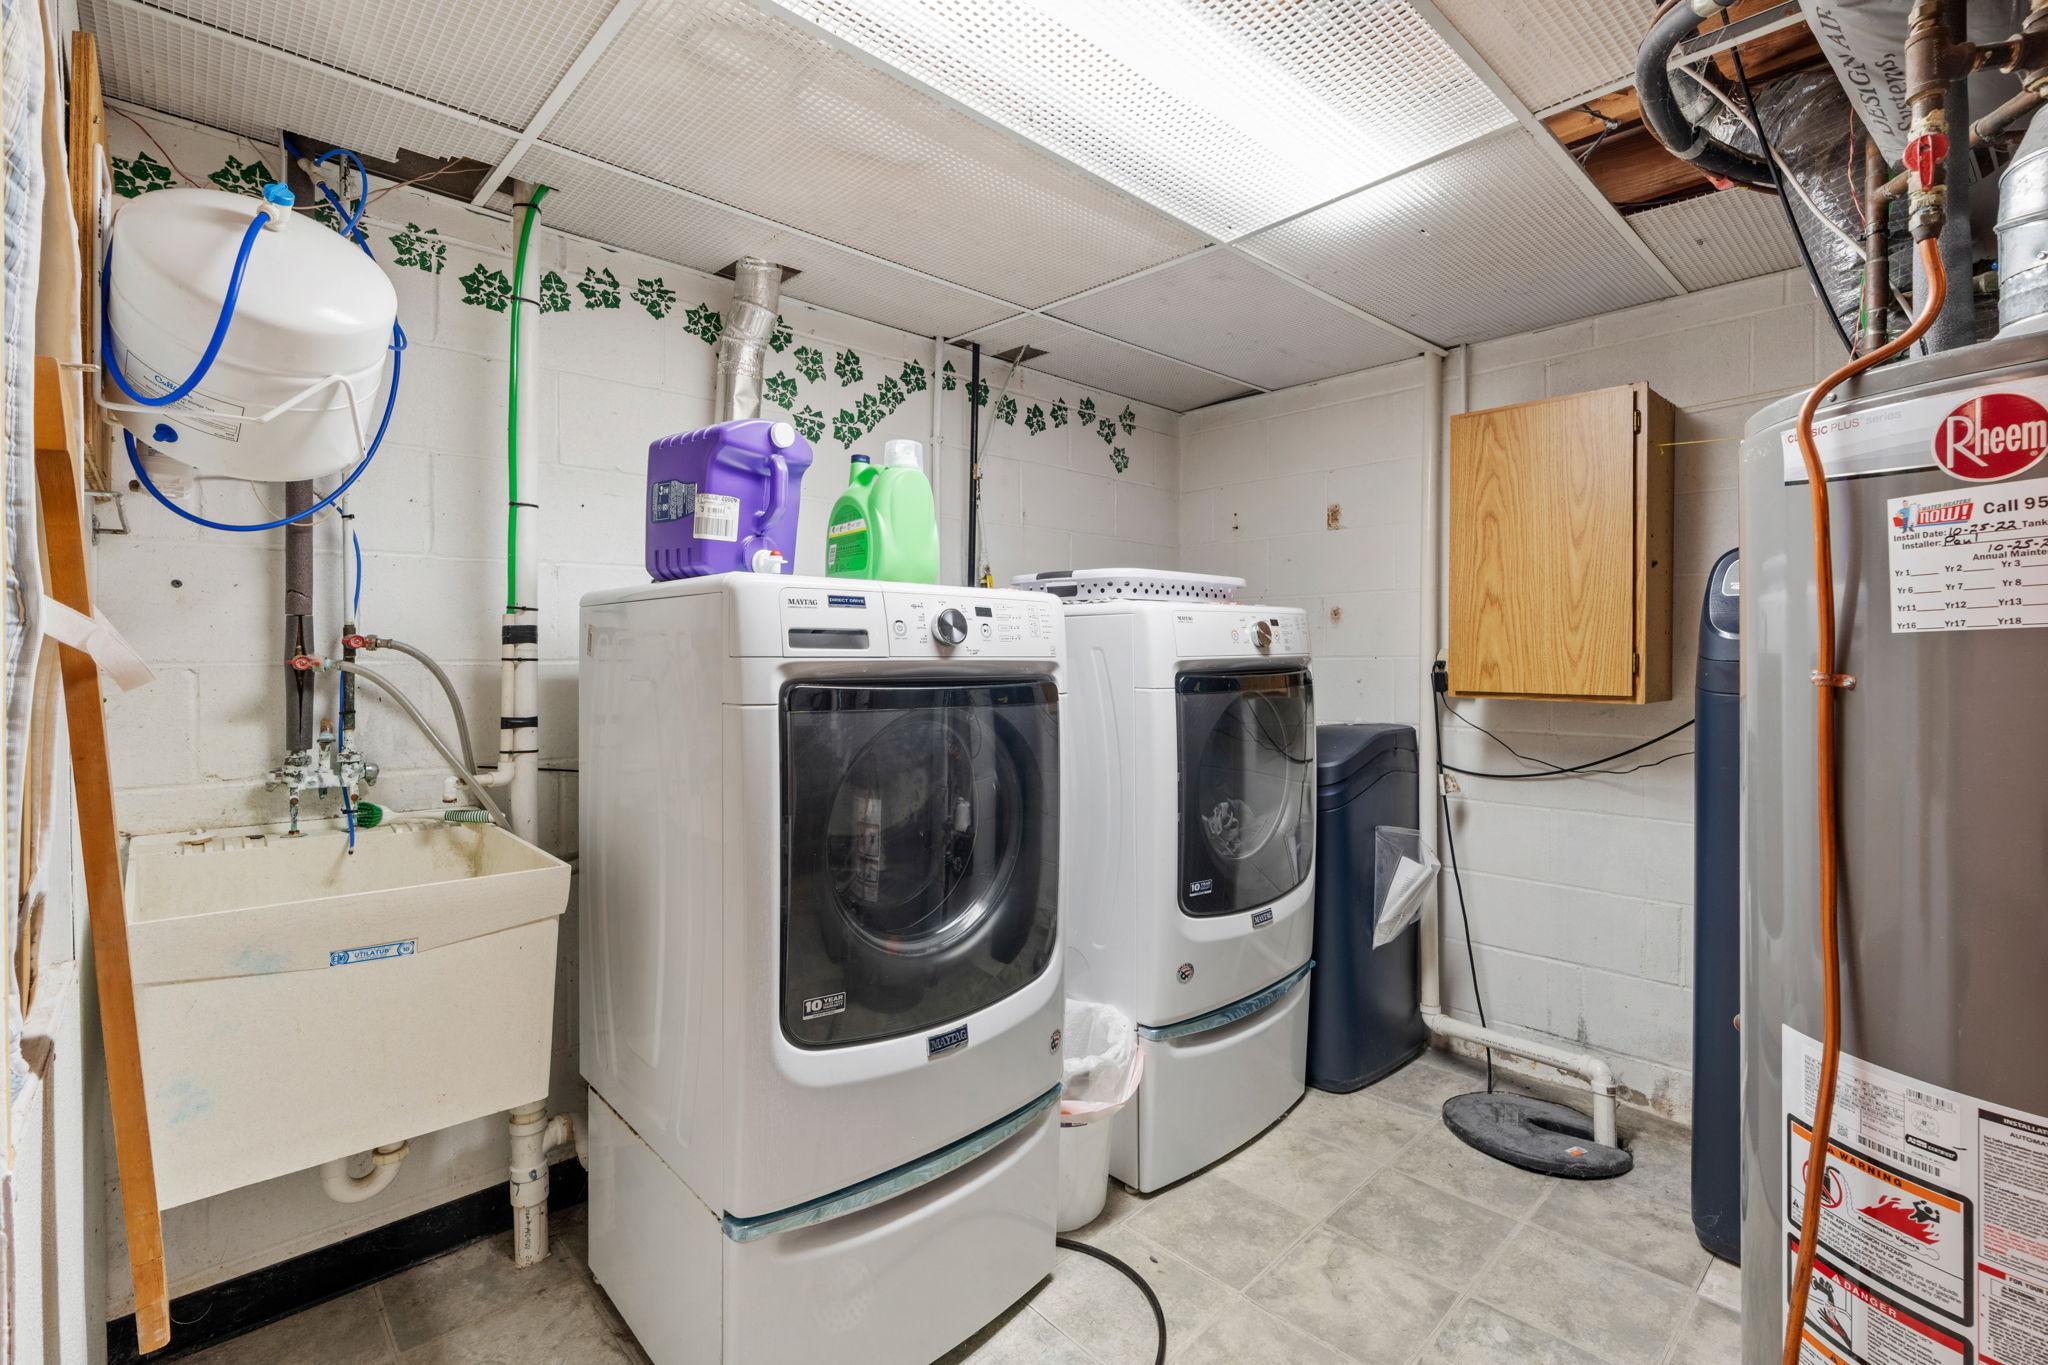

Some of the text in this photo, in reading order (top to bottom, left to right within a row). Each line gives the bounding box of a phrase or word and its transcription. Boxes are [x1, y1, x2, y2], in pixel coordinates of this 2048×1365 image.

[1787, 410, 1902, 444] CLSIC PLUS series
[1946, 396, 2047, 469] Rheem
[1919, 504, 1970, 524] now!
[1983, 495, 2048, 514] Call 95
[2022, 518, 2048, 528] Tank
[1893, 530, 1946, 542] Install Date:
[1902, 540, 1942, 550] Installer:
[1972, 550, 2008, 561] Annual
[787, 598, 818, 606] MAYTAG
[1191, 883, 1200, 892] 10
[354, 948, 390, 958] UTILATUB
[805, 1000, 822, 1013] 10
[824, 994, 844, 1004] YEAR
[930, 1030, 968, 1051] MAYTAG
[1840, 1153, 1902, 1187] WARNING
[1858, 1216, 1920, 1250] Flammable Vapors
[1881, 1242, 1906, 1259] HAZARD
[1844, 1280, 1897, 1318] DANGER
